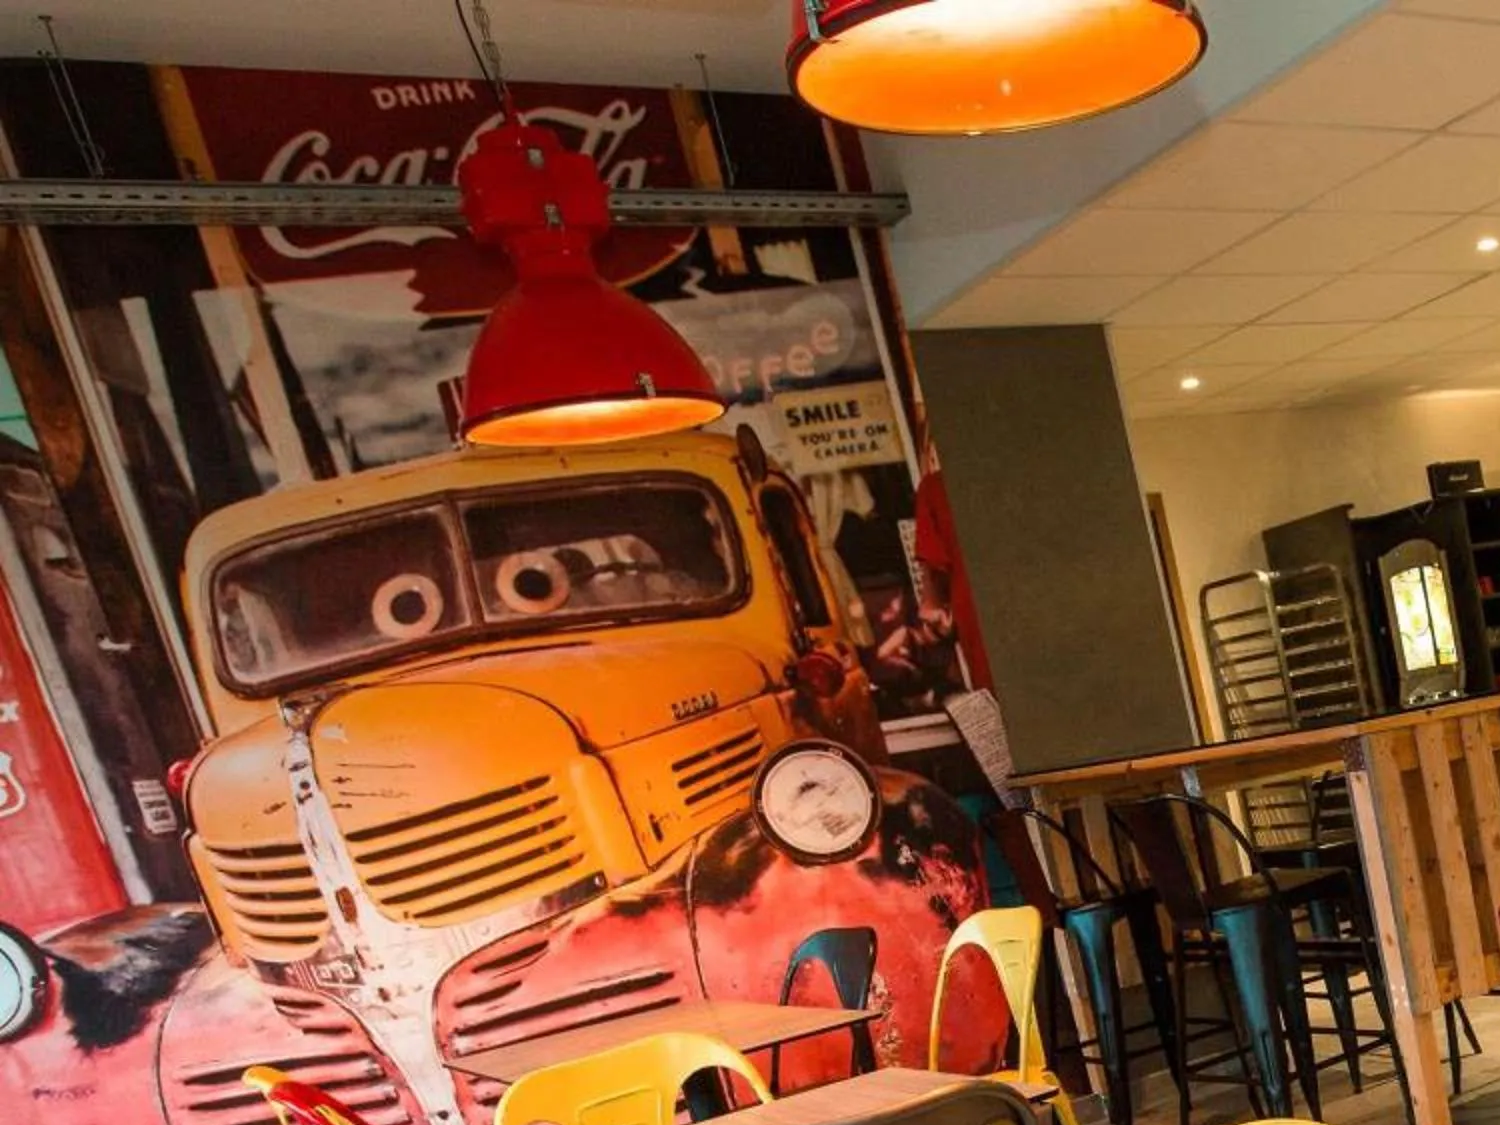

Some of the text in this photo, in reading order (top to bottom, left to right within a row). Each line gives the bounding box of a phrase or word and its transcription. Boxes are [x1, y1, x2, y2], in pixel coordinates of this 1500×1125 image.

[370, 80, 476, 110] DRINK
[784, 399, 862, 428] SMILE
[799, 423, 889, 446] YOU'RE ON
[813, 440, 881, 459] CAMERA
